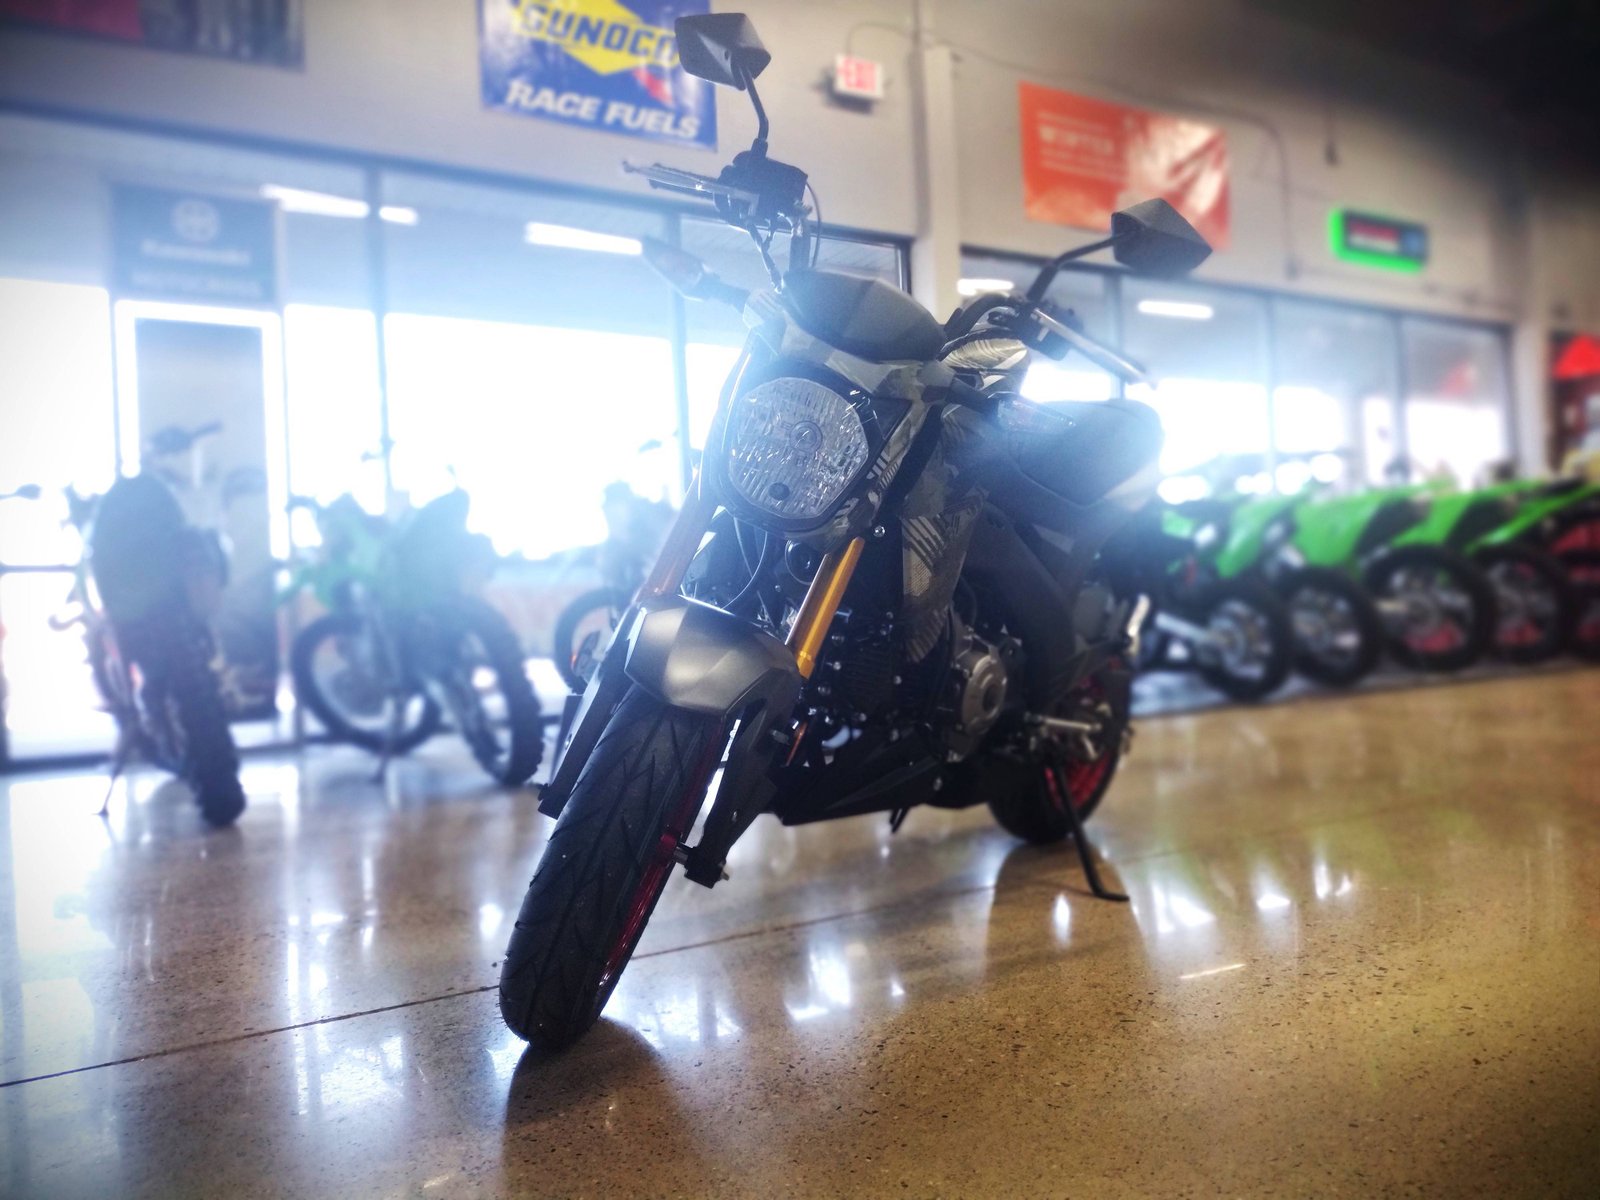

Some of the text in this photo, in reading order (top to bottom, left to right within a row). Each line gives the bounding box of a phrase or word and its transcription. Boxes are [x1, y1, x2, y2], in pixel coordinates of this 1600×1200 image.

[522, 3, 678, 63] SUNOCO
[506, 80, 700, 138] RACE FUELS
